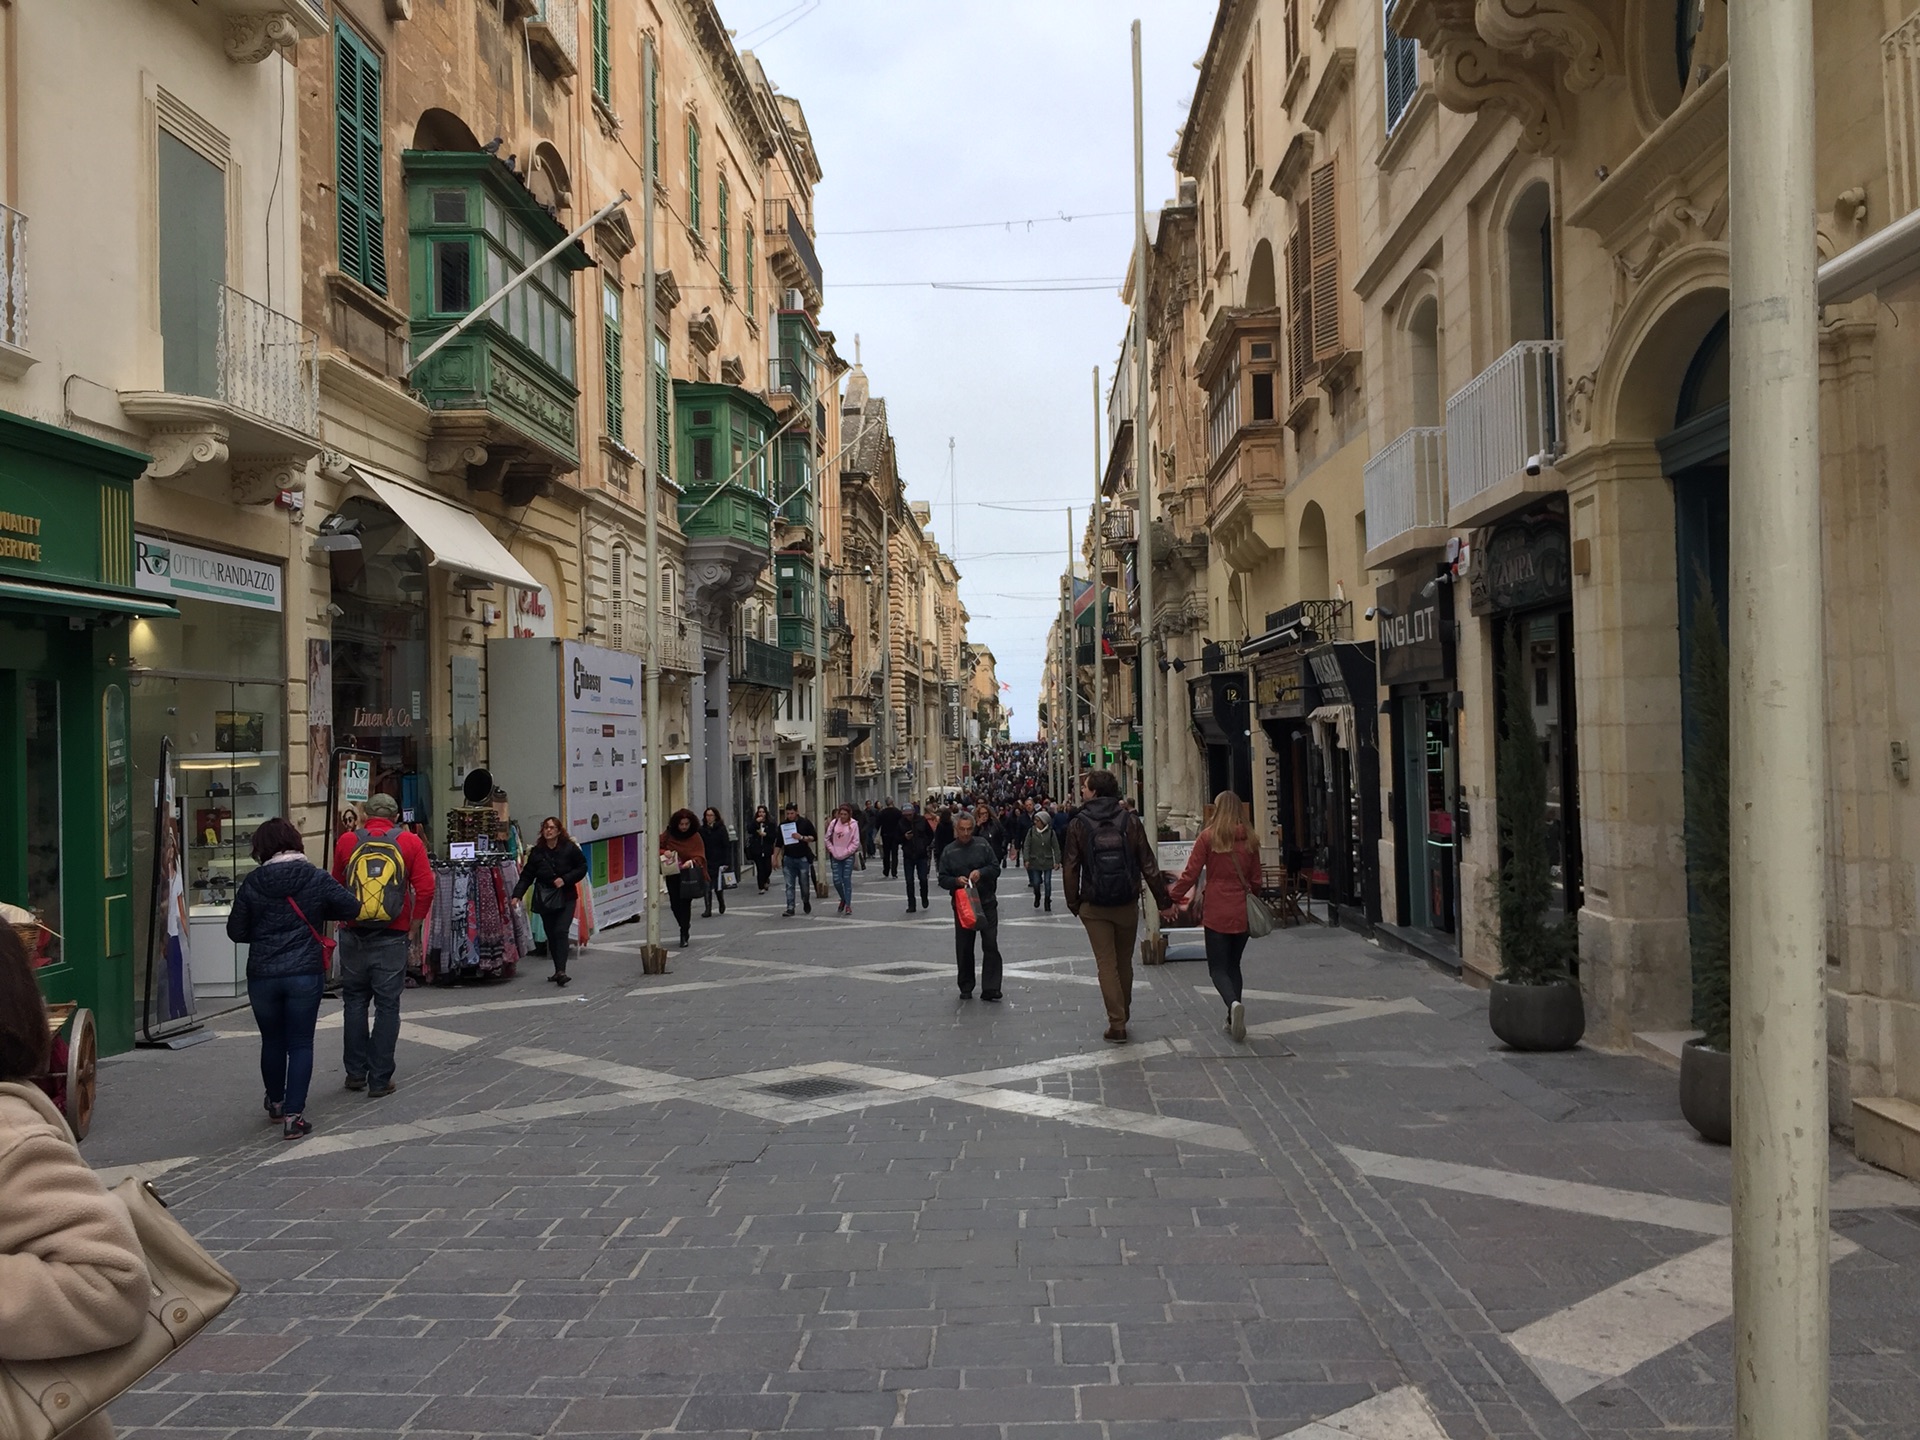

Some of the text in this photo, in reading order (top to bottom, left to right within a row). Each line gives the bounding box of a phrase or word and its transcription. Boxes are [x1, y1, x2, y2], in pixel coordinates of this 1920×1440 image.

[0, 537, 41, 562] SERVICE
[1381, 606, 1435, 650] INGLOT
[1226, 689, 1237, 700] 12
[353, 706, 383, 727] Linen
[386, 708, 394, 727] &
[461, 847, 470, 858] 4
